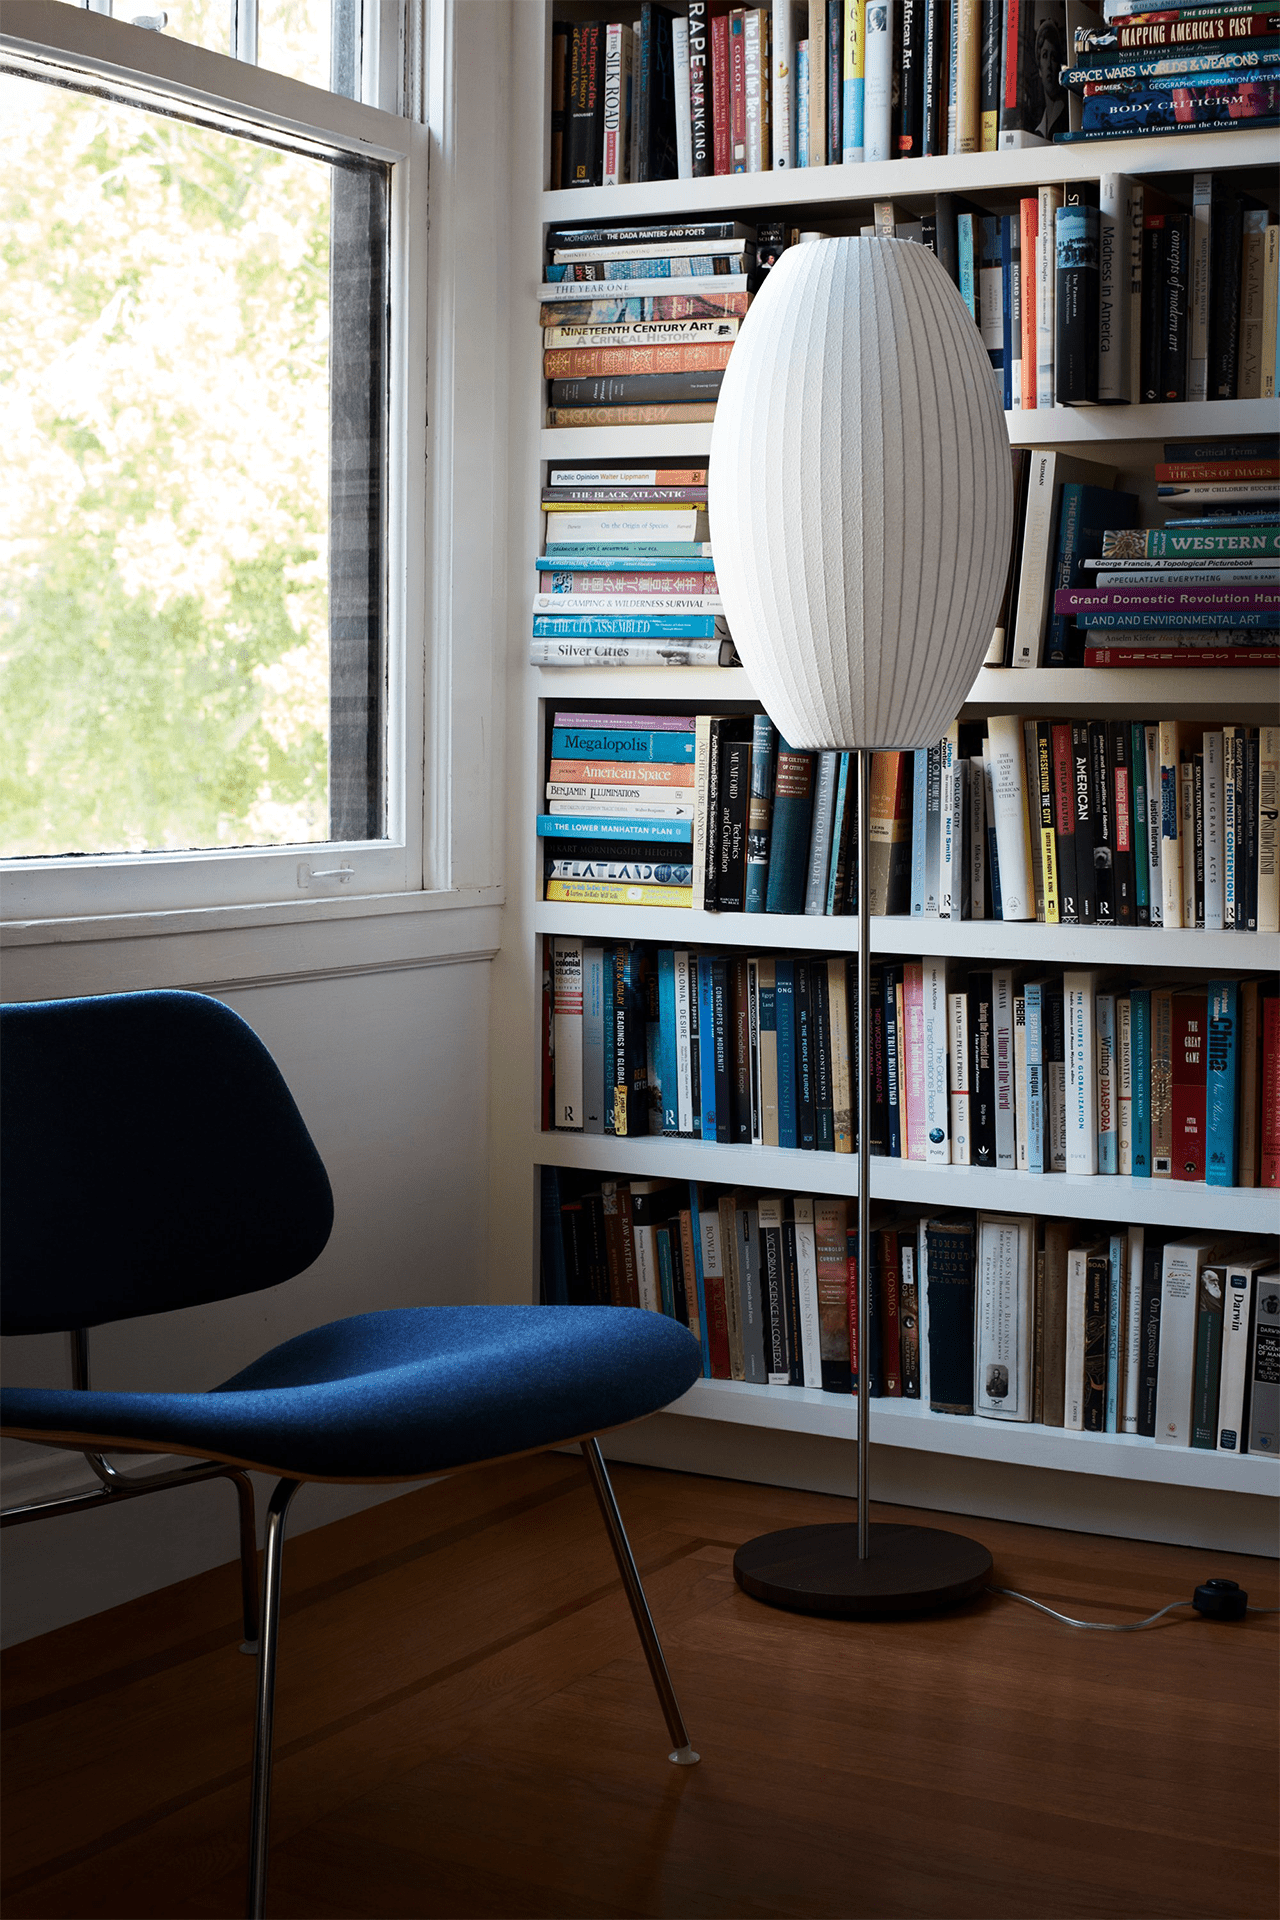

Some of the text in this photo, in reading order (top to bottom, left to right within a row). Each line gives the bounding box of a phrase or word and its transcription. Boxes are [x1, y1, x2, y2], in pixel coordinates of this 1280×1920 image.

[1223, 5, 1253, 13] GARDEN
[677, 30, 689, 68] blink
[902, 0, 914, 70] African Art
[1121, 25, 1165, 47] MAPPING
[1170, 19, 1224, 42] AMERICA'S
[1229, 16, 1253, 36] PAST
[604, 35, 620, 130] THE SILK ROAD
[689, 2, 706, 160] RAPE NANKING
[735, 45, 746, 92] COLOR
[1069, 53, 1259, 84] SPACE WARS WORLDS WEAPONS
[1149, 80, 1195, 90] GEOGRAPHIC
[1198, 77, 1248, 87] INFORMATION
[1110, 95, 1245, 114] BODY CRITICISM
[1151, 119, 1238, 132] Forms from Ocean
[563, 228, 706, 243] MOTHERWELL THE DADA PAINTERS AND POETS
[554, 283, 630, 294] THE YEAR ONE
[1012, 265, 1020, 296] RICHARD
[1100, 226, 1116, 353] Madness in America
[1167, 229, 1186, 352] concepts of modern art
[560, 322, 714, 337] NINETEENTH CENTURY ART
[590, 332, 698, 345] CRITICAL HISTORY
[556, 473, 600, 482] Public Opinion
[570, 490, 686, 499] THE BLACK ATLANTIC
[1170, 536, 1268, 550] WESTERN
[1094, 559, 1254, 568] George Topological Picturebook
[1168, 575, 1221, 583] EVERYTHING
[614, 599, 704, 608] WILDERNESS SURVIVAL
[1069, 593, 1250, 605] Grand Domestic Revolution
[594, 620, 651, 633] ASSEMBLED
[1084, 614, 1261, 626] LAND AND ENVIRONMENTAL ART
[557, 645, 630, 657] Silver Cities
[564, 735, 648, 753] Megalopolis
[550, 785, 641, 799] BENJAMIN ILLUMINATIONS
[582, 766, 672, 781] American Space
[729, 751, 740, 799] MUMFORD
[1039, 738, 1052, 825] RE-PRESENTING THE CITY
[1075, 756, 1089, 821] AMERICAN
[1059, 761, 1070, 831] OUTLAW CULTURE
[554, 823, 673, 835] THE LOWER MANHATTAN PLAN
[812, 755, 831, 886] LEWIS MUMFORD READER
[1150, 799, 1160, 868] Justice Interruptus
[1209, 776, 1217, 884] IMMIGRANT ACTS
[721, 807, 731, 873] and Civilization
[732, 822, 742, 860] Technics
[1226, 783, 1235, 903] FEMINIST CONTENTIONS
[678, 962, 688, 1039] COLONIAL DESIRE
[715, 986, 724, 1025] CONSCRIPTS
[1015, 999, 1026, 1026] FREIRE
[616, 1010, 625, 1056] READINGS IN
[1184, 1036, 1201, 1048] GREAT
[1187, 1020, 1199, 1033] THE
[1209, 1017, 1233, 1072] China
[716, 1037, 725, 1073] MODERNITY
[737, 1012, 747, 1094] Provincializing Europe
[801, 1038, 809, 1063] PEOPLE
[1029, 1013, 1040, 1097] SEPARATE UNEQUAL
[1077, 1051, 1084, 1061] OF
[1122, 1042, 1131, 1089] DISCONTENTS
[819, 1049, 827, 1101] CONTINENTS
[957, 1061, 965, 1090] PROCESS
[998, 1037, 1011, 1110] Home in the World
[1099, 1035, 1112, 1132] Writing DIASPORA
[1077, 1065, 1085, 1129] GLOBALIZATION
[798, 1210, 808, 1218] 12
[621, 1217, 634, 1284] RAW MATERIAL
[705, 1225, 716, 1269] BOWLER
[1088, 1261, 1106, 1269] BOAS
[766, 1232, 782, 1368] VICTORIAN SCIENCE IN CONTEXT
[887, 1271, 897, 1317] COSMOS
[1231, 1293, 1244, 1331] Darwin
[1146, 1297, 1161, 1369] On Aggression
